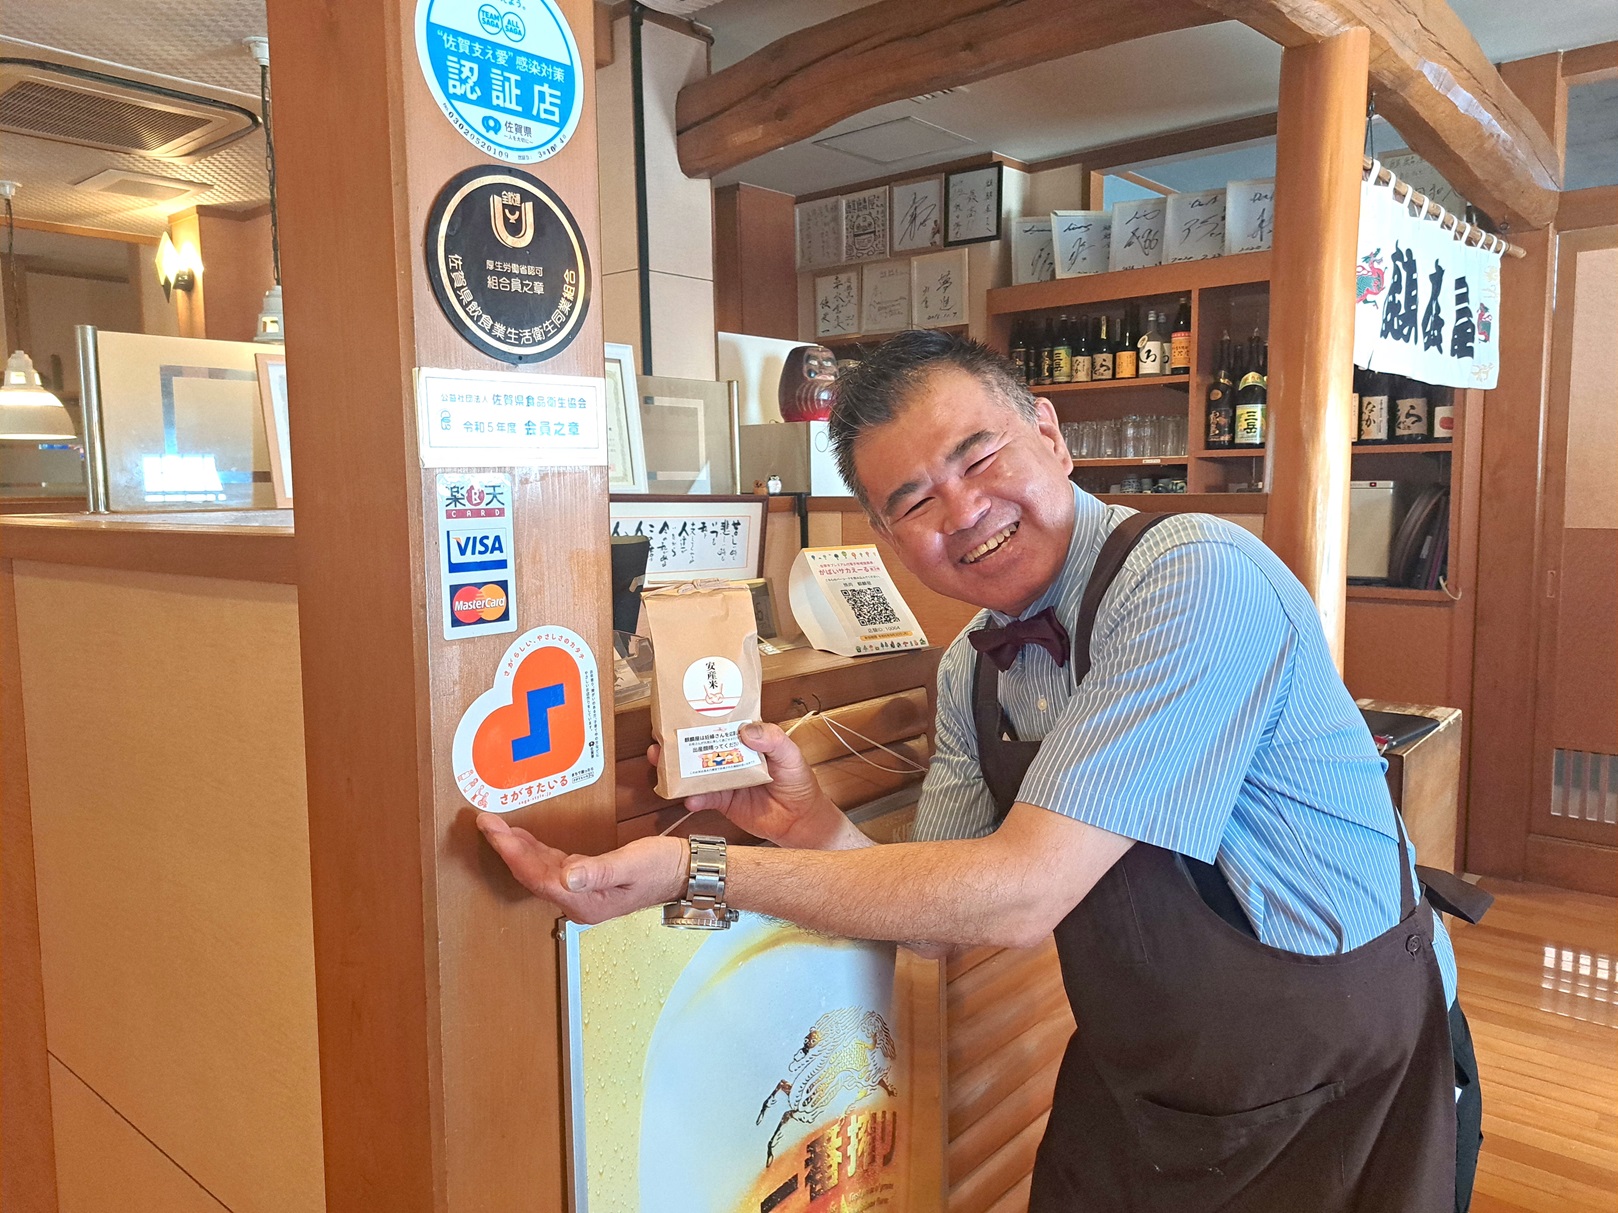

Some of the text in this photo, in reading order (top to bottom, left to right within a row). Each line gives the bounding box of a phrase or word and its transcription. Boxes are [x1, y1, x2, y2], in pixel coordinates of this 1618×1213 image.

[481, 9, 500, 22] TEAM
[481, 17, 500, 29] SAGA
[507, 18, 520, 29] ALL
[505, 24, 522, 36] SAGA
[515, 57, 565, 83] 感染対策
[447, 55, 562, 124] 認証店
[504, 120, 532, 138] 佐賀県
[486, 260, 543, 277] 厚生労働省認可
[487, 276, 545, 295] 組合員之章
[492, 393, 587, 409] 佐賀県食品衛生協会
[463, 420, 580, 437] 令和5年度 会員之章
[1244, 410, 1258, 434] 三岳
[451, 509, 501, 518] CARD
[452, 535, 504, 557] VISA
[454, 596, 505, 612] MasterCard
[503, 633, 585, 677] さがらしい、やさしさのカタチ
[705, 661, 718, 690] 安産米
[500, 775, 569, 806] さがすたいる
